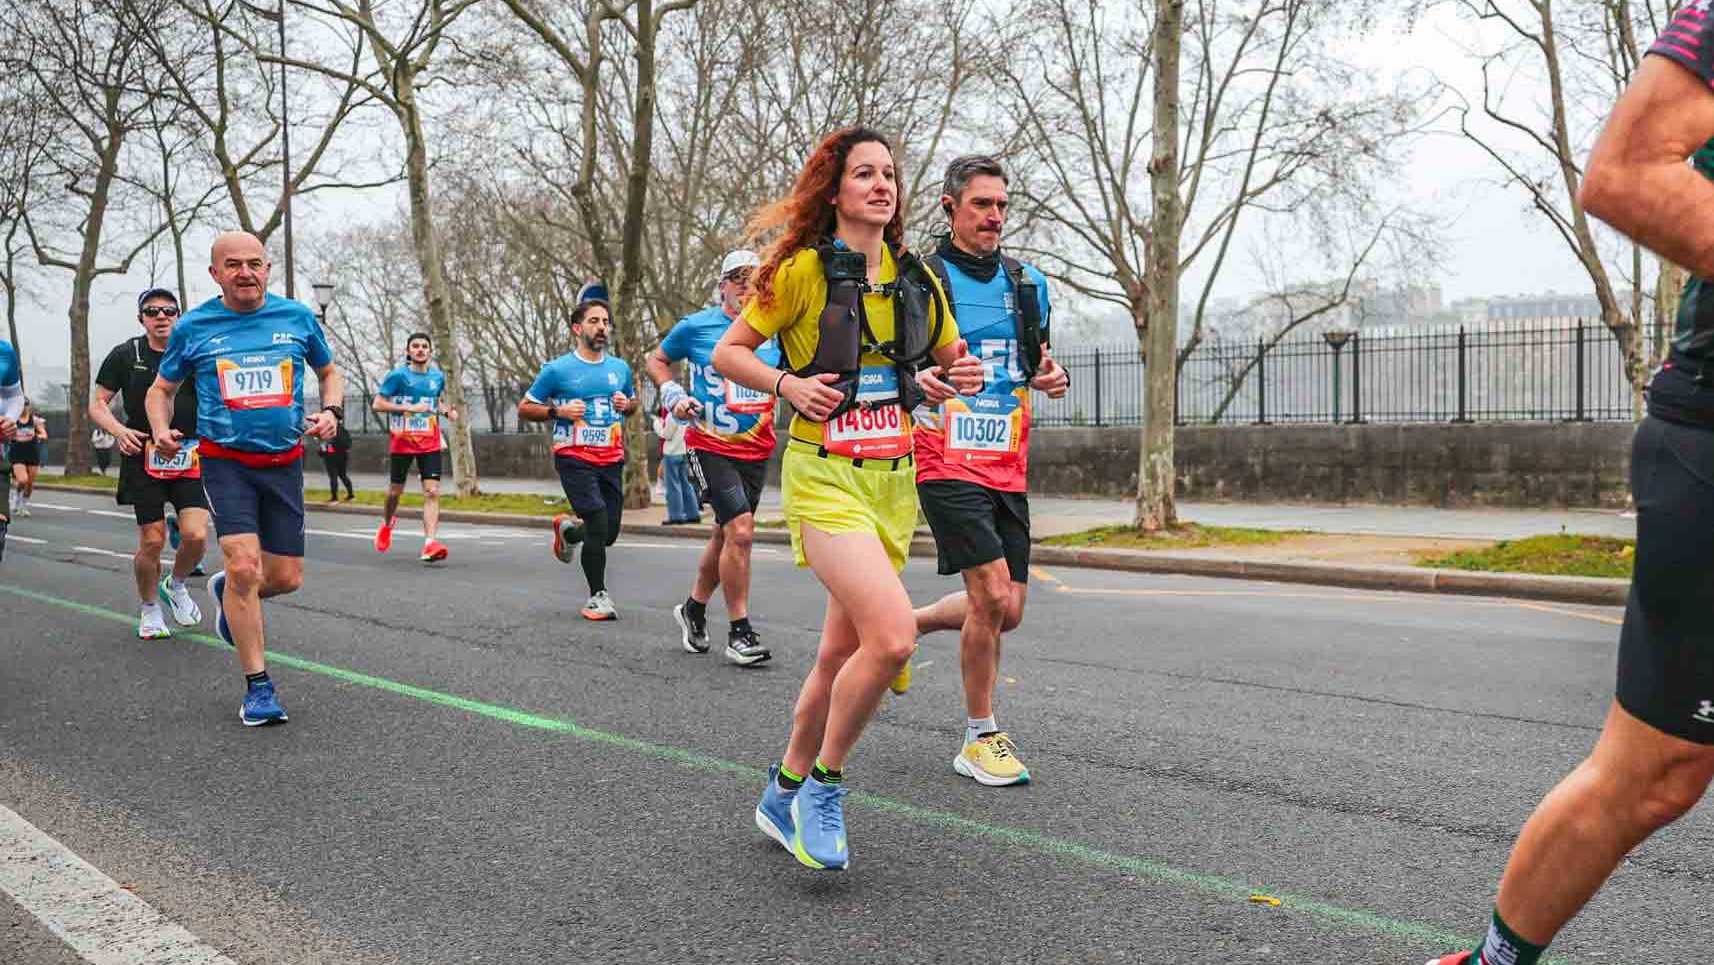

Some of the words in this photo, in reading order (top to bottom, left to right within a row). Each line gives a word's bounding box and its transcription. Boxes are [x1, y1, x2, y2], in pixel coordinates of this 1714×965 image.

[235, 370, 272, 390] 9719
[582, 429, 606, 442] 9595
[957, 417, 1006, 442] 10302
